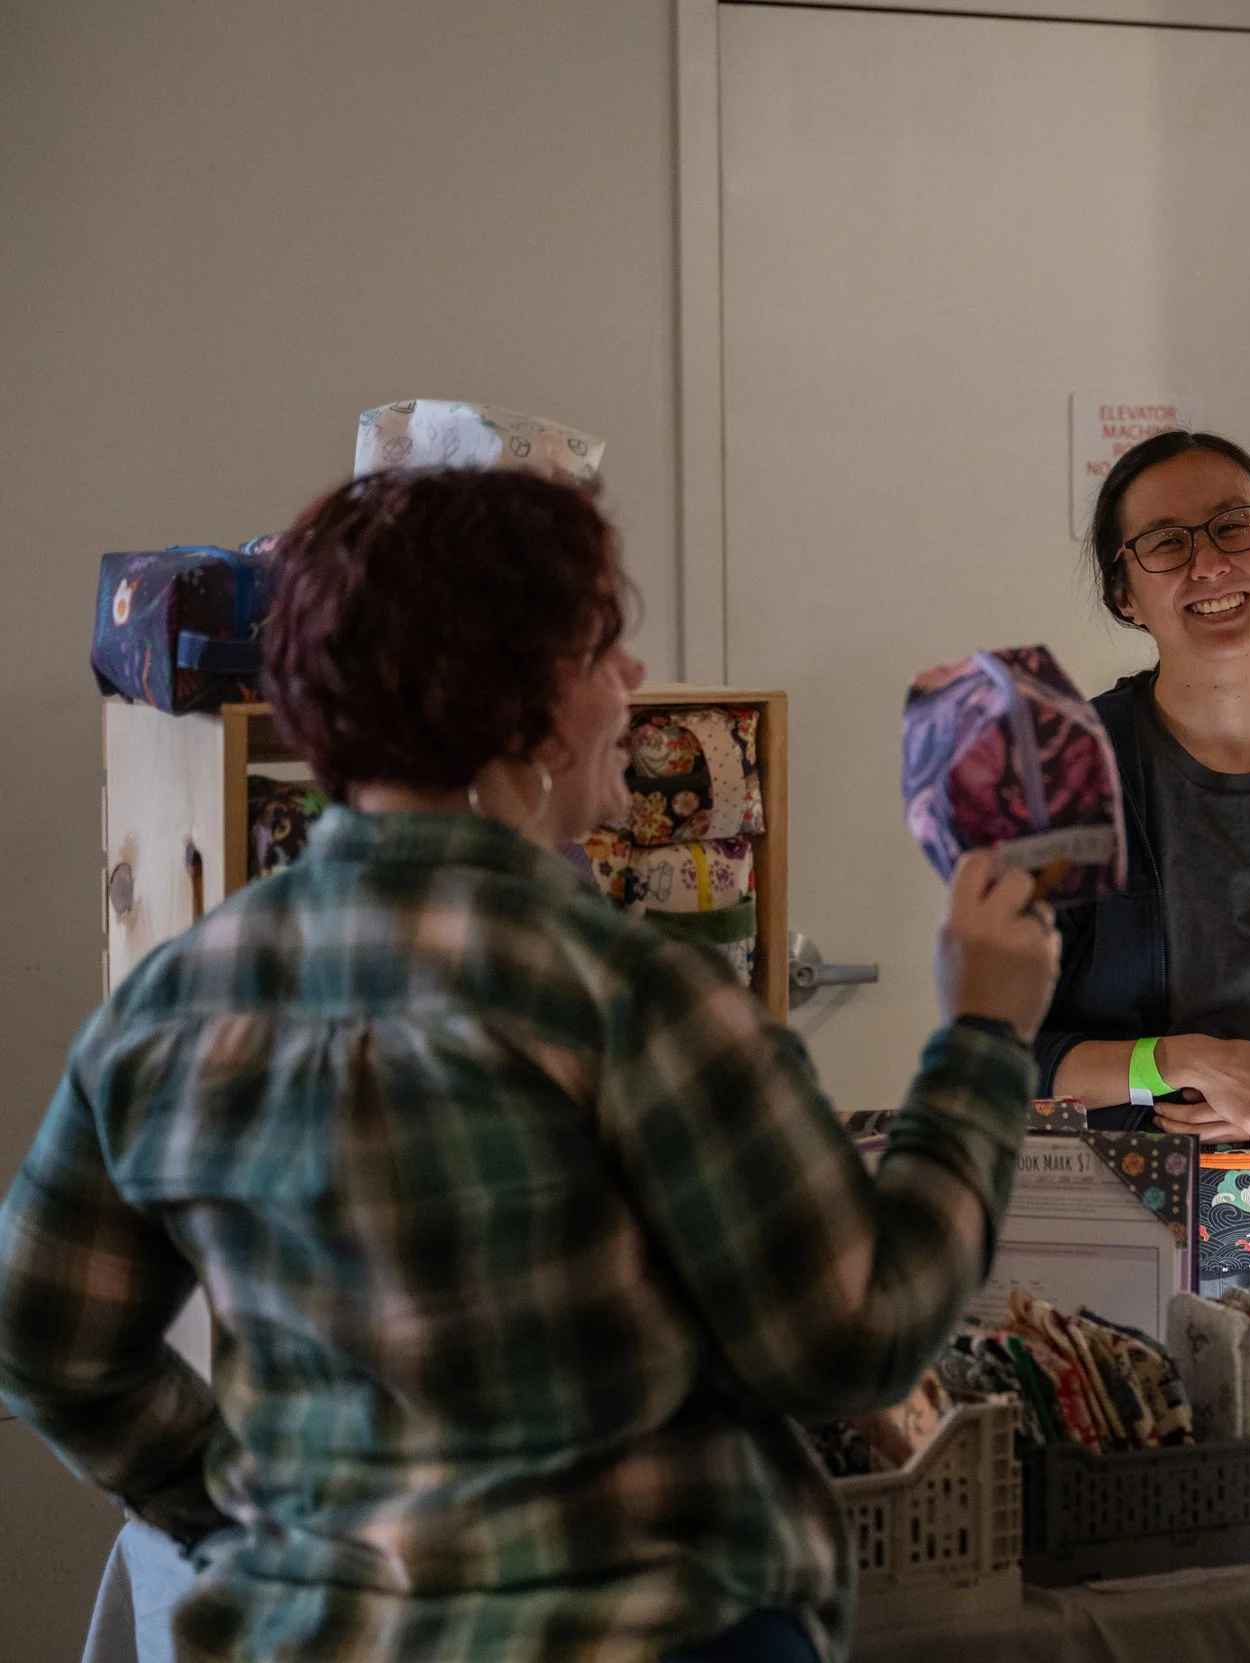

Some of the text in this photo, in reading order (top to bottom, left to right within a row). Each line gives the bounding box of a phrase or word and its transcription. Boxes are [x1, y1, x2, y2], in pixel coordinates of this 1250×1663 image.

[1099, 404, 1176, 421] ELEVATOR
[1017, 1155, 1040, 1172] OOK
[1043, 1153, 1073, 1172] MARK
